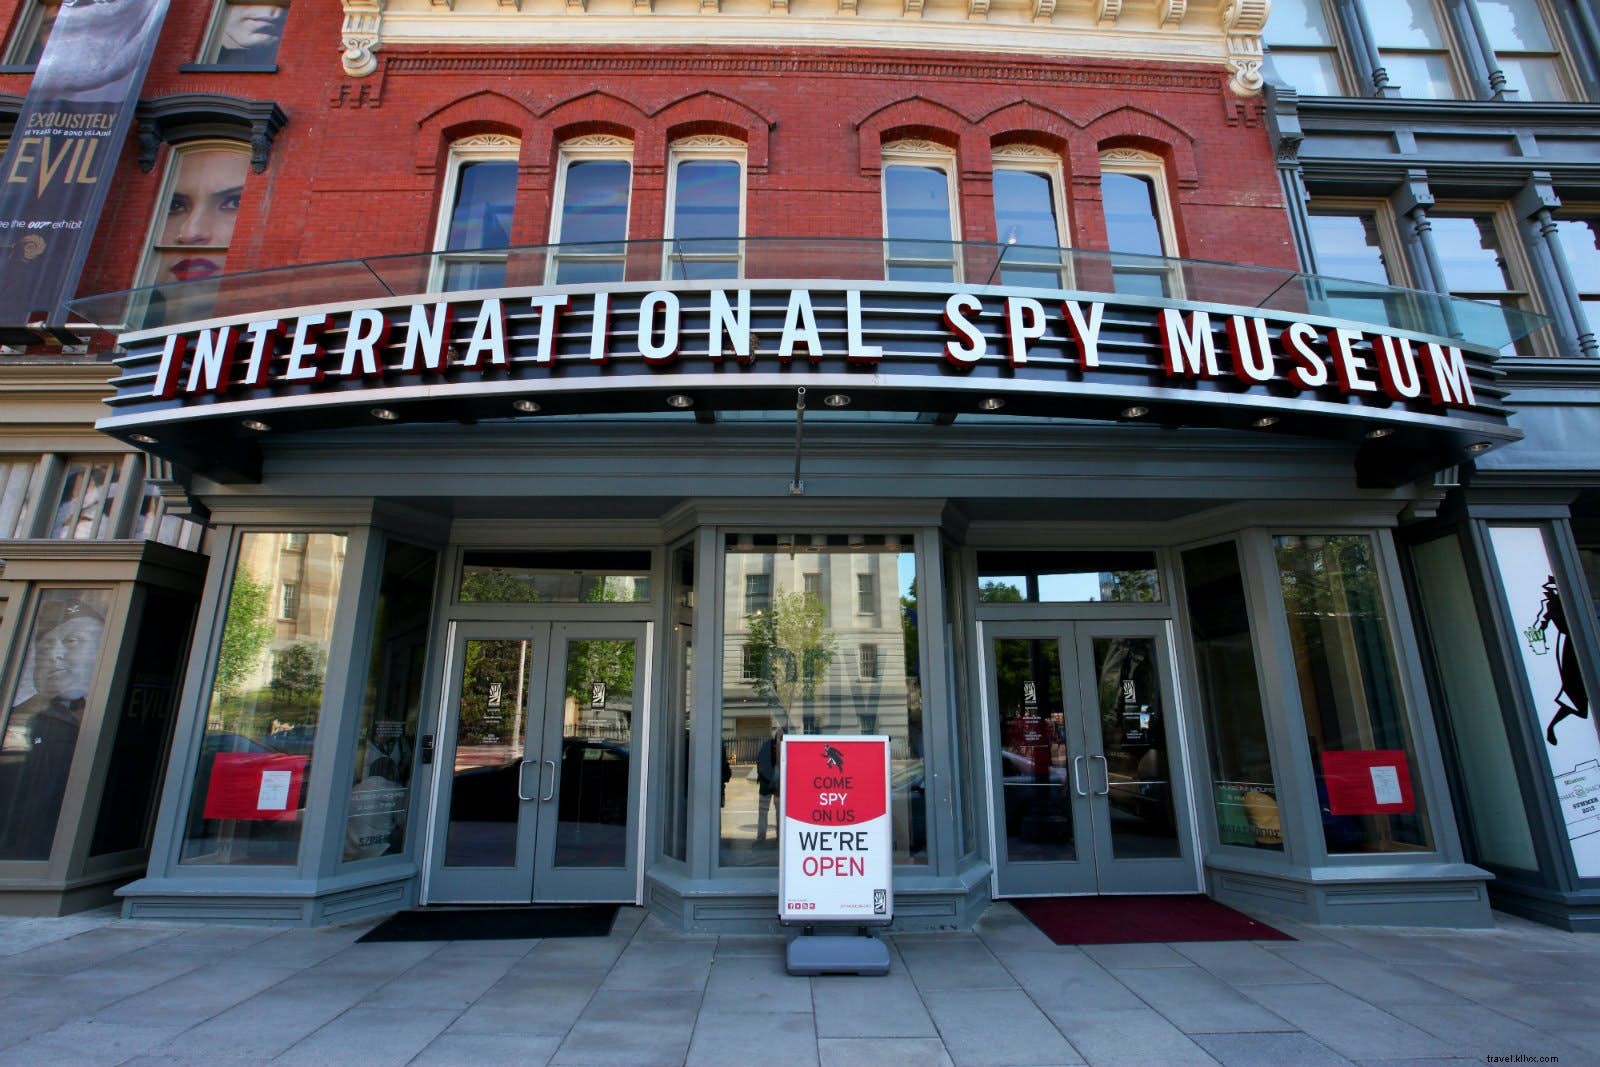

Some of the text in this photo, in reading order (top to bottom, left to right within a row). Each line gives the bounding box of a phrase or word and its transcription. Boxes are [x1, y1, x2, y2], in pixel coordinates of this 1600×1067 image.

[27, 112, 117, 129] EXQUISITELY
[7, 136, 98, 199] EVIL
[11, 219, 26, 229] the
[52, 219, 82, 229] exhibit
[151, 289, 1476, 407] INTERNATIONAL SPY MUSEUM
[813, 776, 854, 789] COME
[819, 793, 847, 805] SPY
[812, 810, 855, 822] ON US
[799, 832, 868, 851] WE'RE
[802, 857, 865, 876] OPEN
